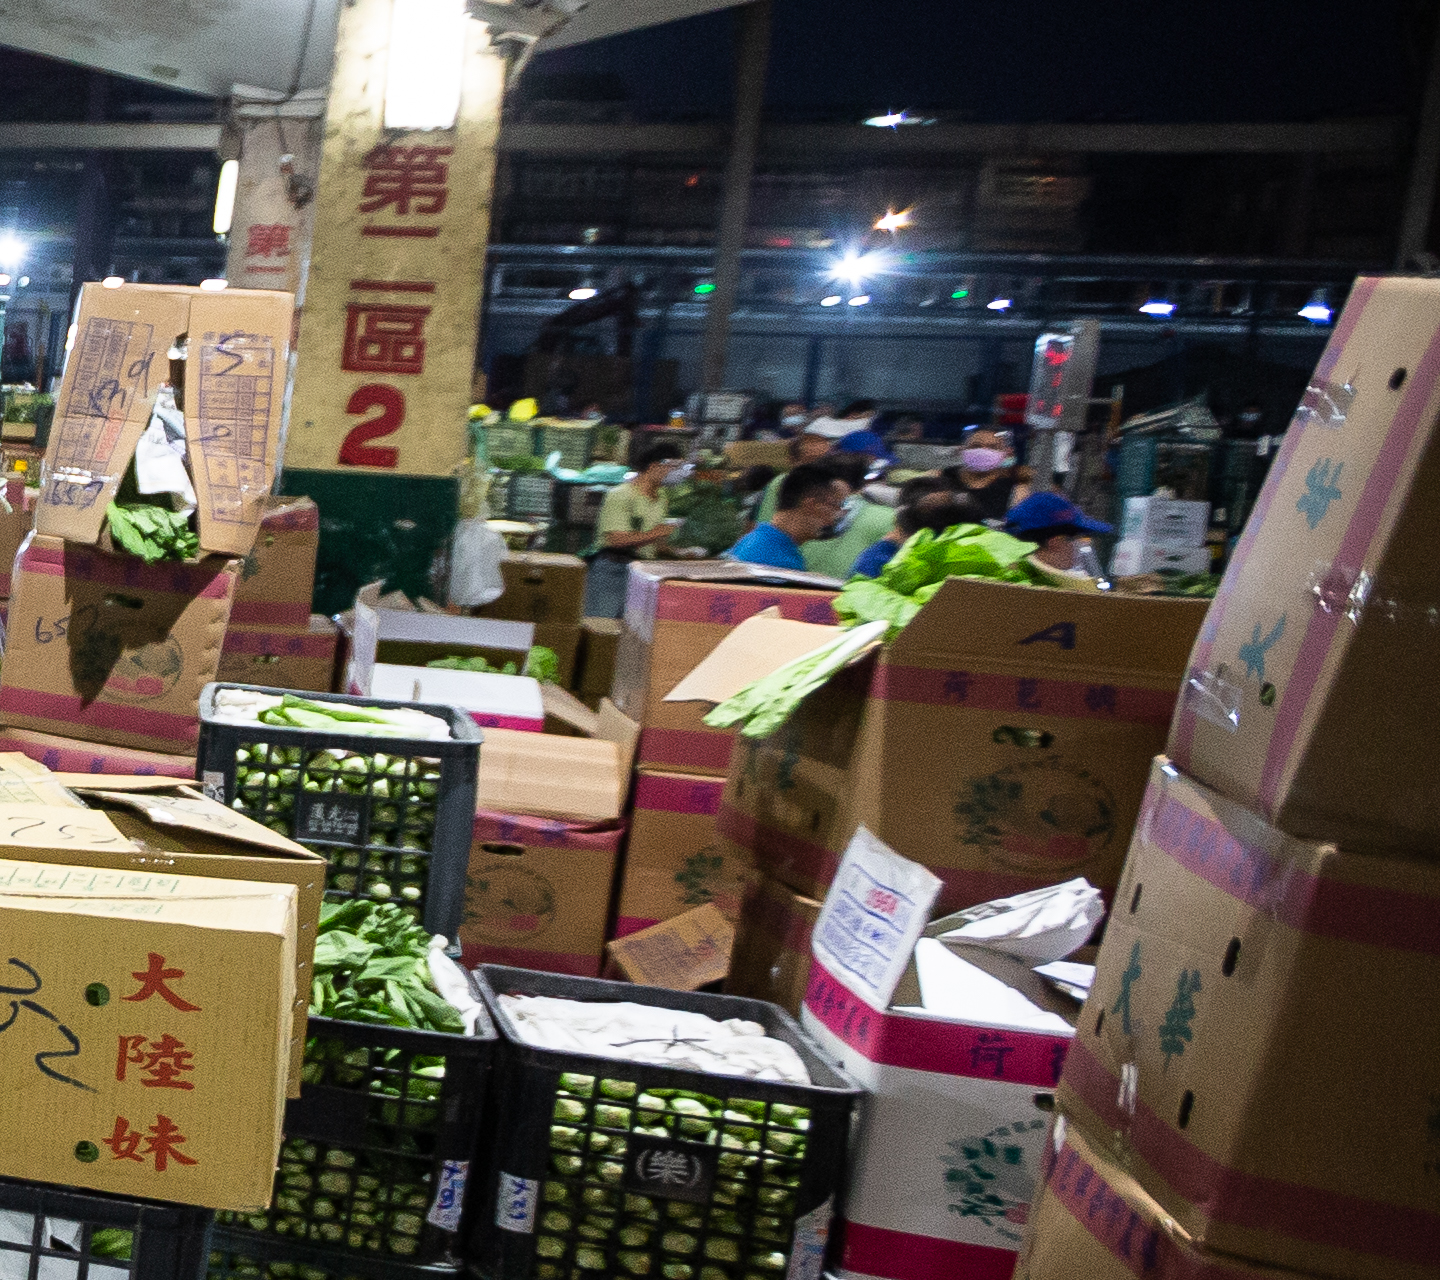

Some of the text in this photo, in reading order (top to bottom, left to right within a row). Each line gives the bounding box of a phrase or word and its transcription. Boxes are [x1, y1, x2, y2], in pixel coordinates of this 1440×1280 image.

[337, 145, 454, 468] 第二區2
[102, 952, 202, 1171] 大陸妹
